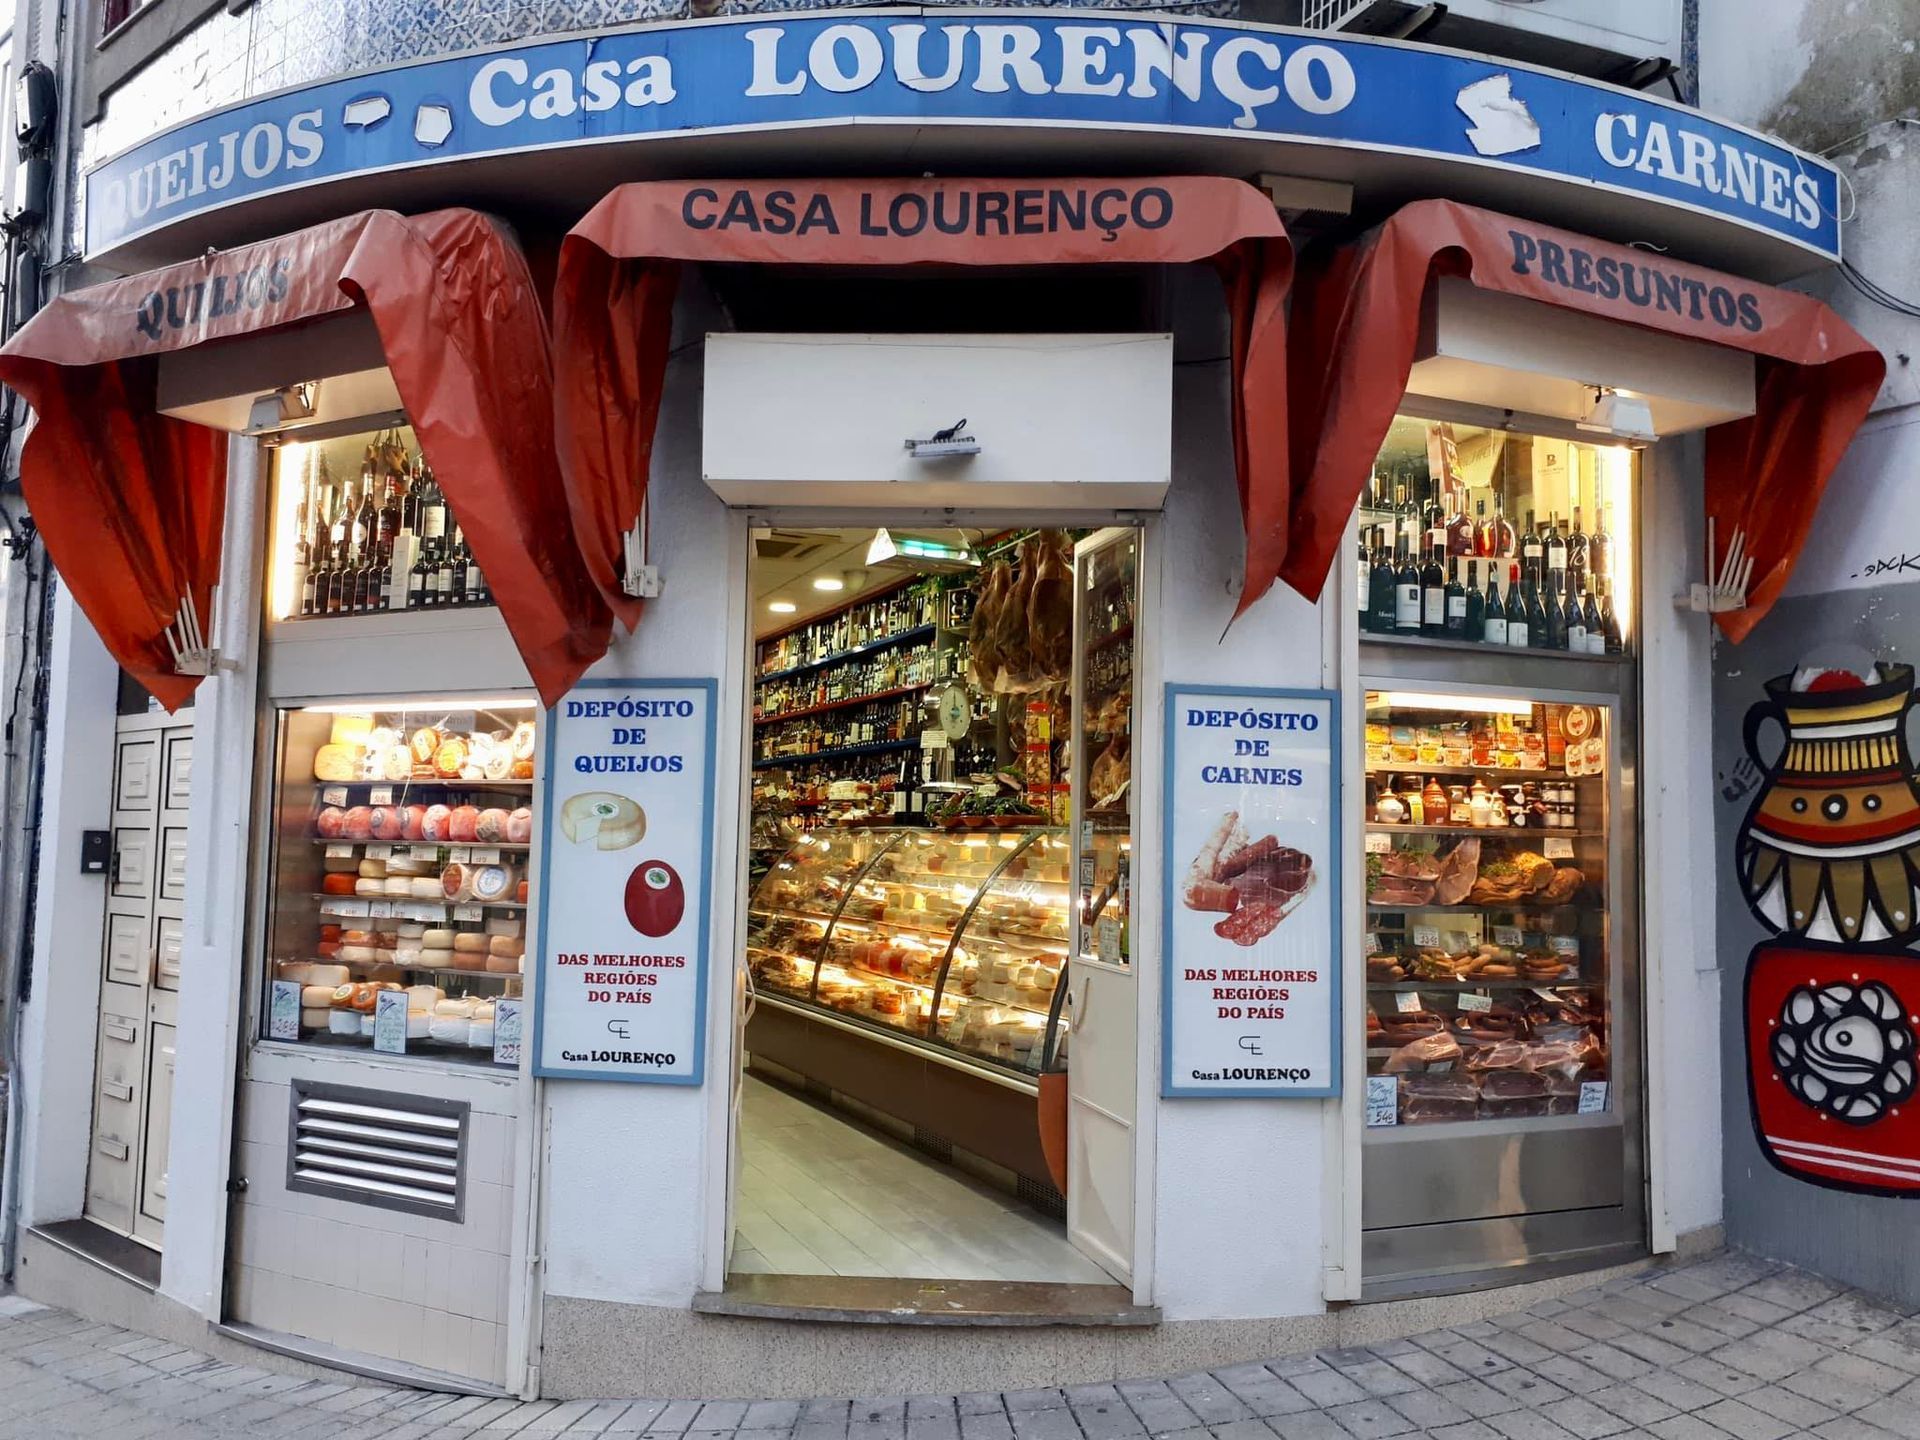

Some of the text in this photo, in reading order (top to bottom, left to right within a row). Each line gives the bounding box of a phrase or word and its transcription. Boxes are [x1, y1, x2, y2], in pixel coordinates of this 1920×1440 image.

[469, 25, 1356, 129] Casa LOURENÇO
[102, 107, 324, 233] QUEIJOS
[1594, 112, 1822, 230] CARNES
[682, 187, 1174, 242] CASA LOURENÇO
[1507, 230, 1763, 332] PRESUNTOS
[567, 695, 694, 718] DEPÓSITO
[1187, 708, 1319, 731] DEPÓSITO
[612, 728, 646, 745] DE
[1234, 739, 1270, 757] DE
[574, 755, 684, 774] QUEIJOS
[1201, 766, 1303, 786] CARNES
[557, 954, 686, 968] DAS MELHORES
[583, 970, 658, 986] REGIÕES
[1184, 969, 1318, 983] DAS MELHORES
[587, 988, 652, 1004] DO PAÍS
[1212, 985, 1290, 1001] REGIÕES
[1217, 1003, 1285, 1019] DO PAÍS
[561, 1050, 676, 1069] Casa LOURENÇO
[1191, 1067, 1311, 1084] Casa LOURENÇO
